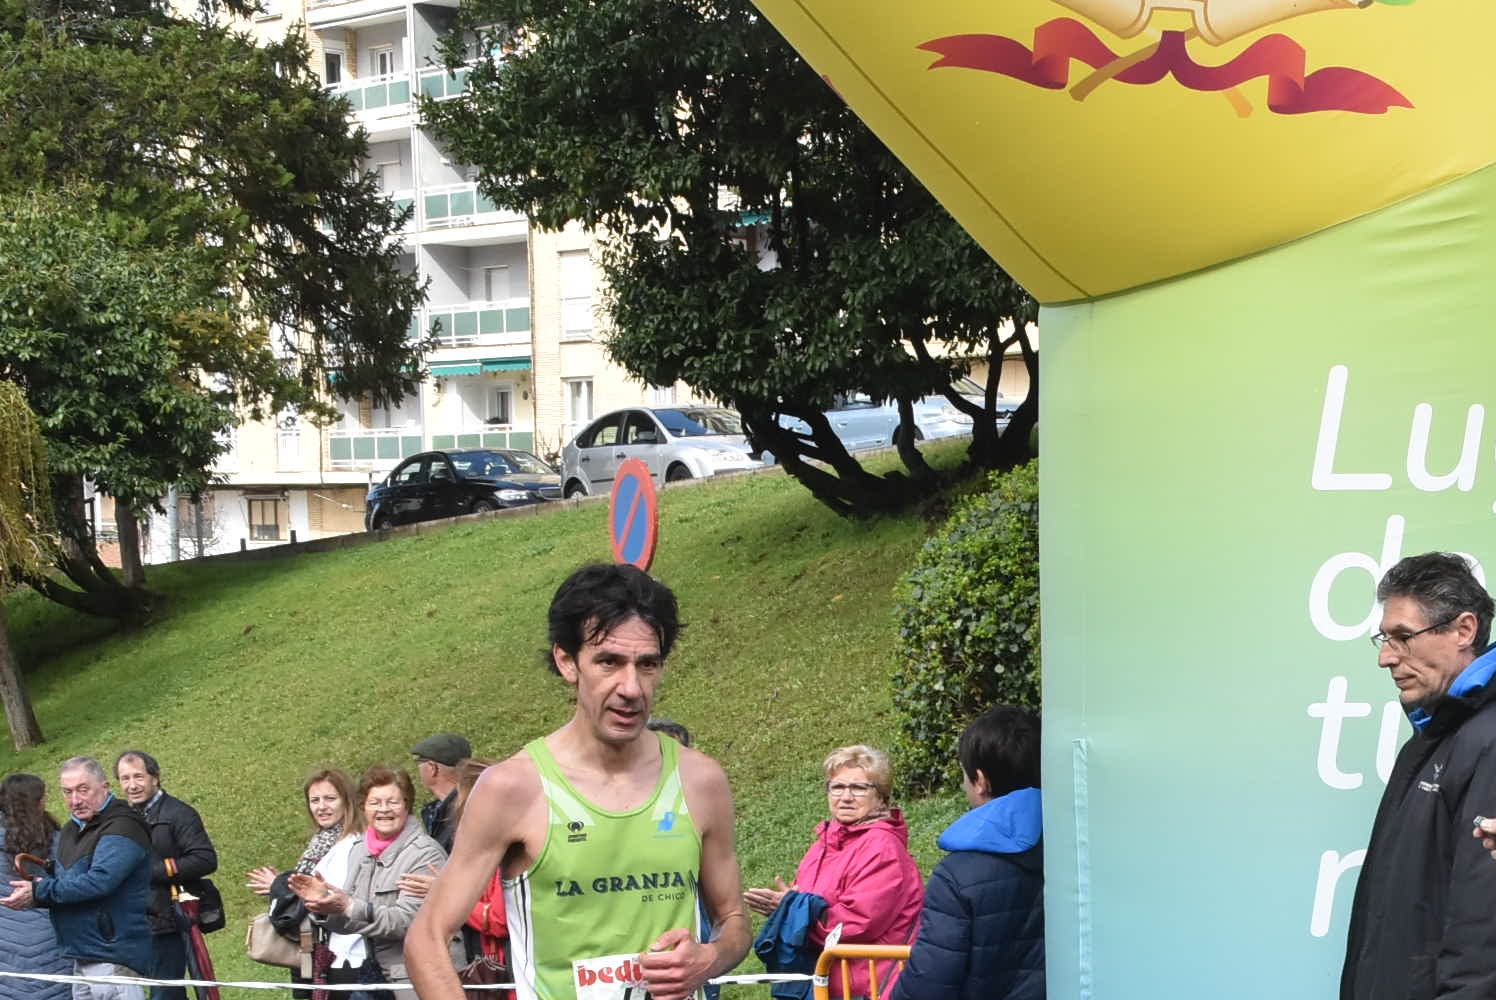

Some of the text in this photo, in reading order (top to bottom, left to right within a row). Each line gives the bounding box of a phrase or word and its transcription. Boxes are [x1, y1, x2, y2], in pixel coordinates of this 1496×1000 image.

[554, 870, 686, 898] LA GRANJA
[641, 894, 654, 903] DE
